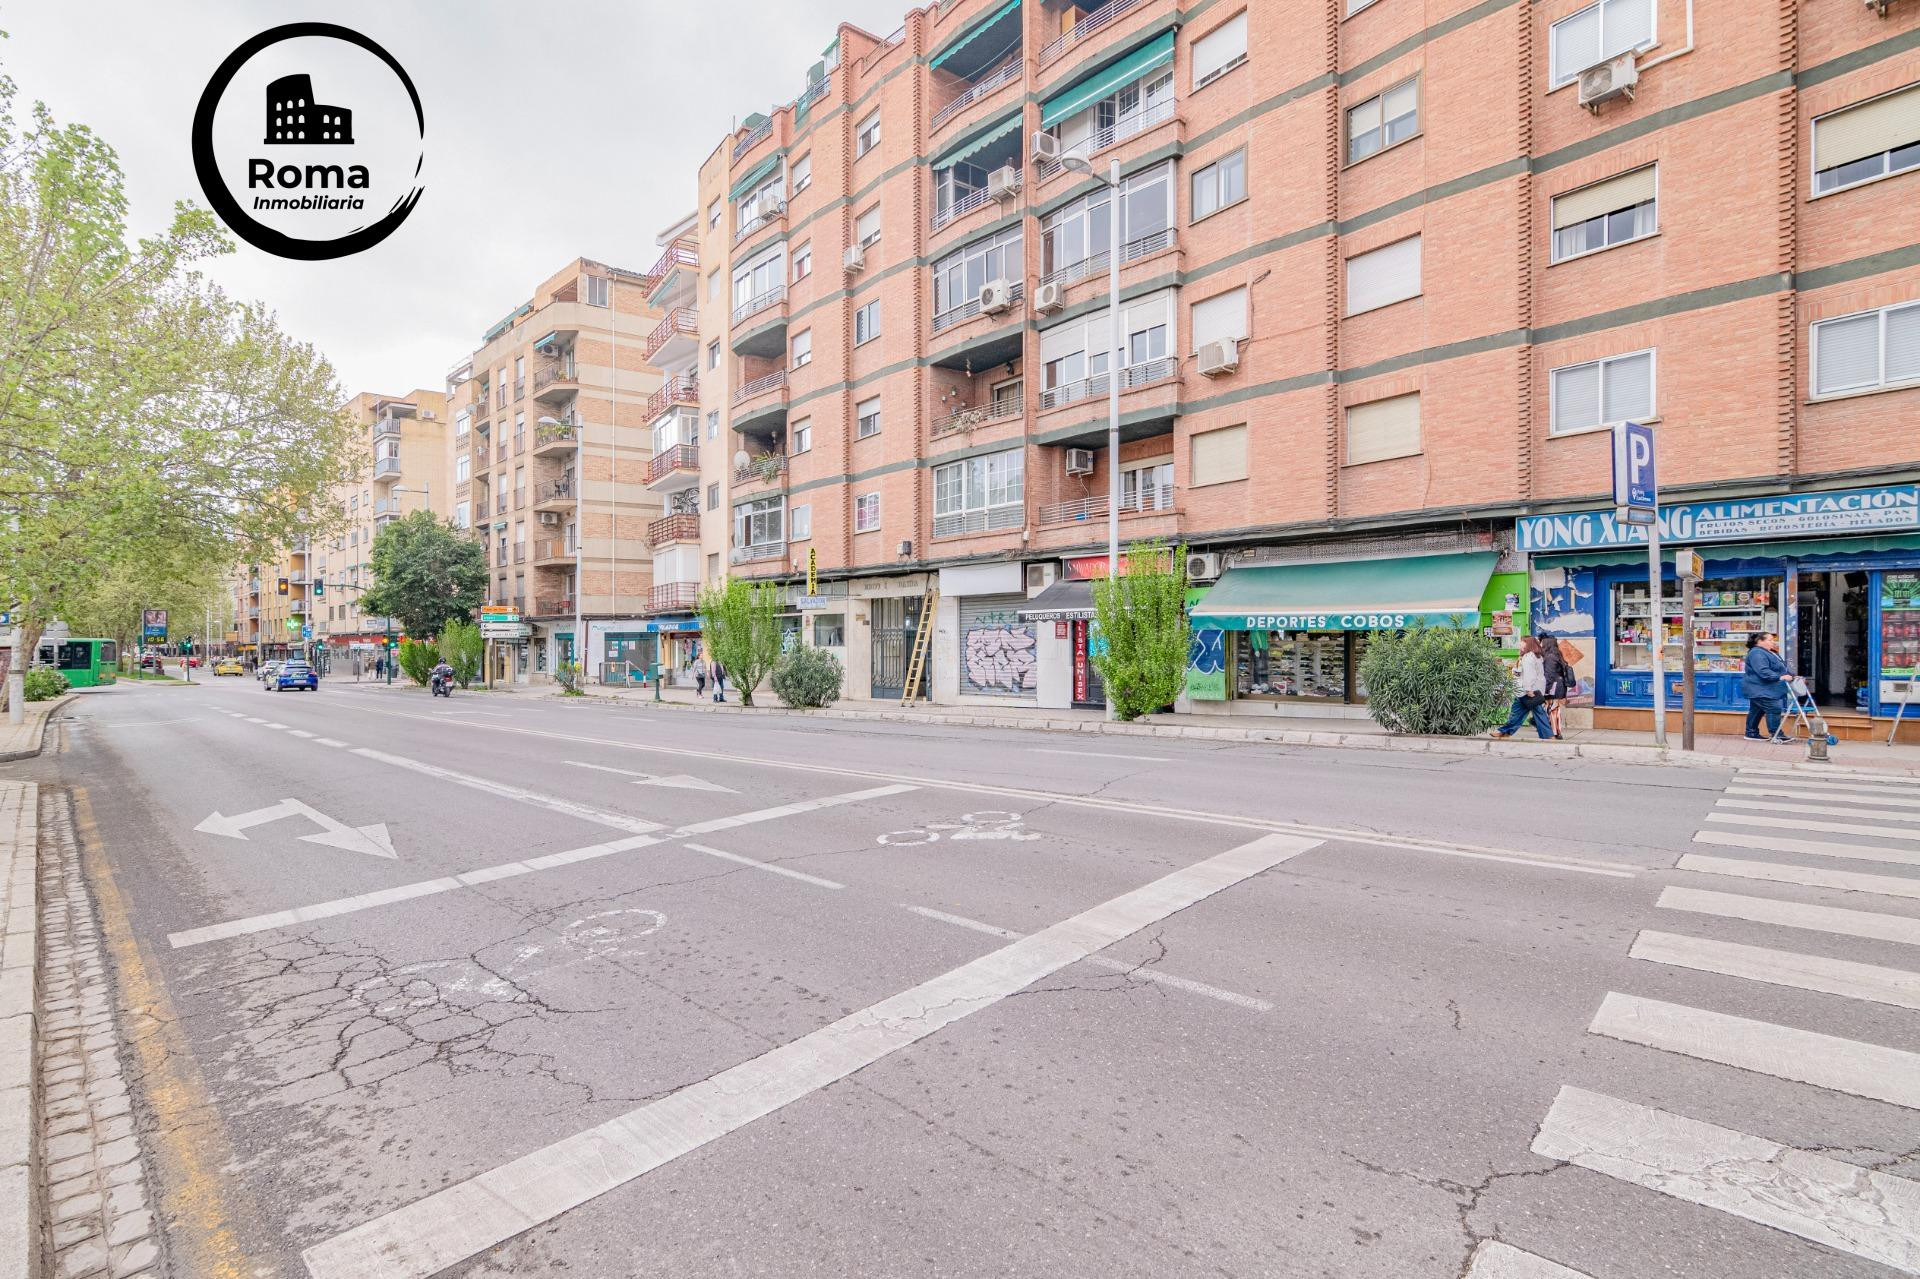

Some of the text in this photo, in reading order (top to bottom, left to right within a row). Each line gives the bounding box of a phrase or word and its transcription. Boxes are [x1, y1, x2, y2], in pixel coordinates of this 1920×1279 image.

[1630, 432, 1650, 484] P
[1696, 489, 1918, 522] ALIMENTACIÓN
[1700, 520, 1744, 529] FRUTOS
[1749, 518, 1786, 526] SECOS
[1798, 512, 1870, 521] GOLOSINAS
[1520, 514, 1592, 549] YONG
[1699, 527, 1748, 535] BEBIDAS
[1025, 612, 1061, 620] PELUQUEROS
[1246, 615, 1405, 628] DEPORTES COBOS
